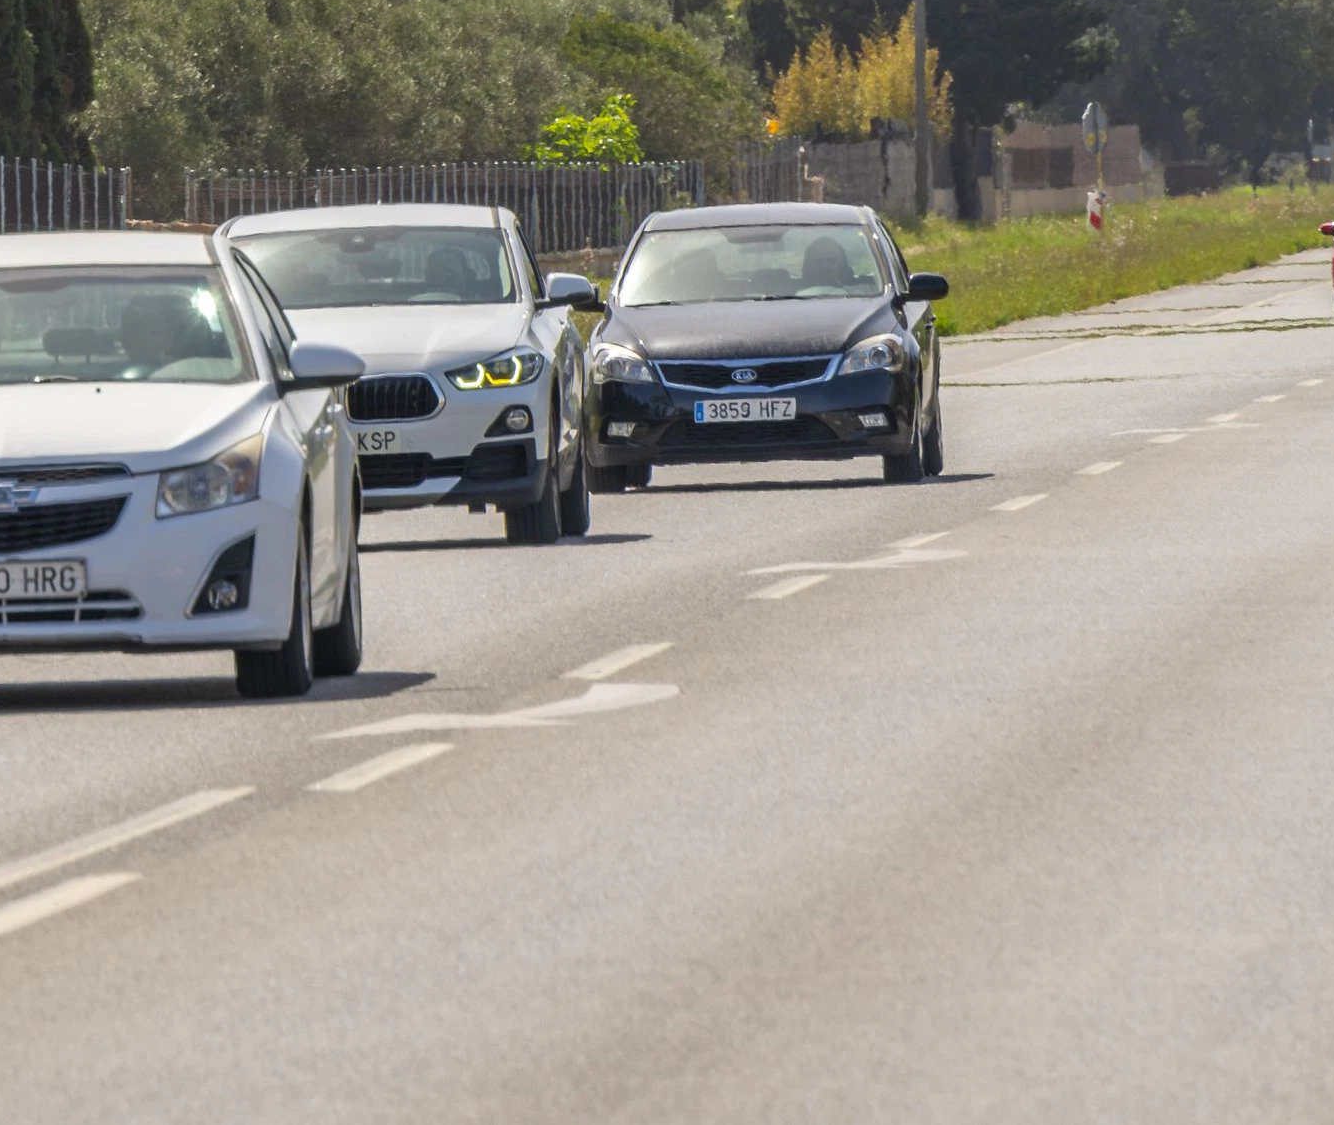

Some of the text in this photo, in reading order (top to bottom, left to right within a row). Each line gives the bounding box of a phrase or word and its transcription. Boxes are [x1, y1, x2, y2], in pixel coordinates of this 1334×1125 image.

[735, 371, 753, 380] KIA
[708, 400, 791, 419] 3859 HFZ
[357, 431, 396, 451] KSP
[23, 566, 76, 593] HRG
